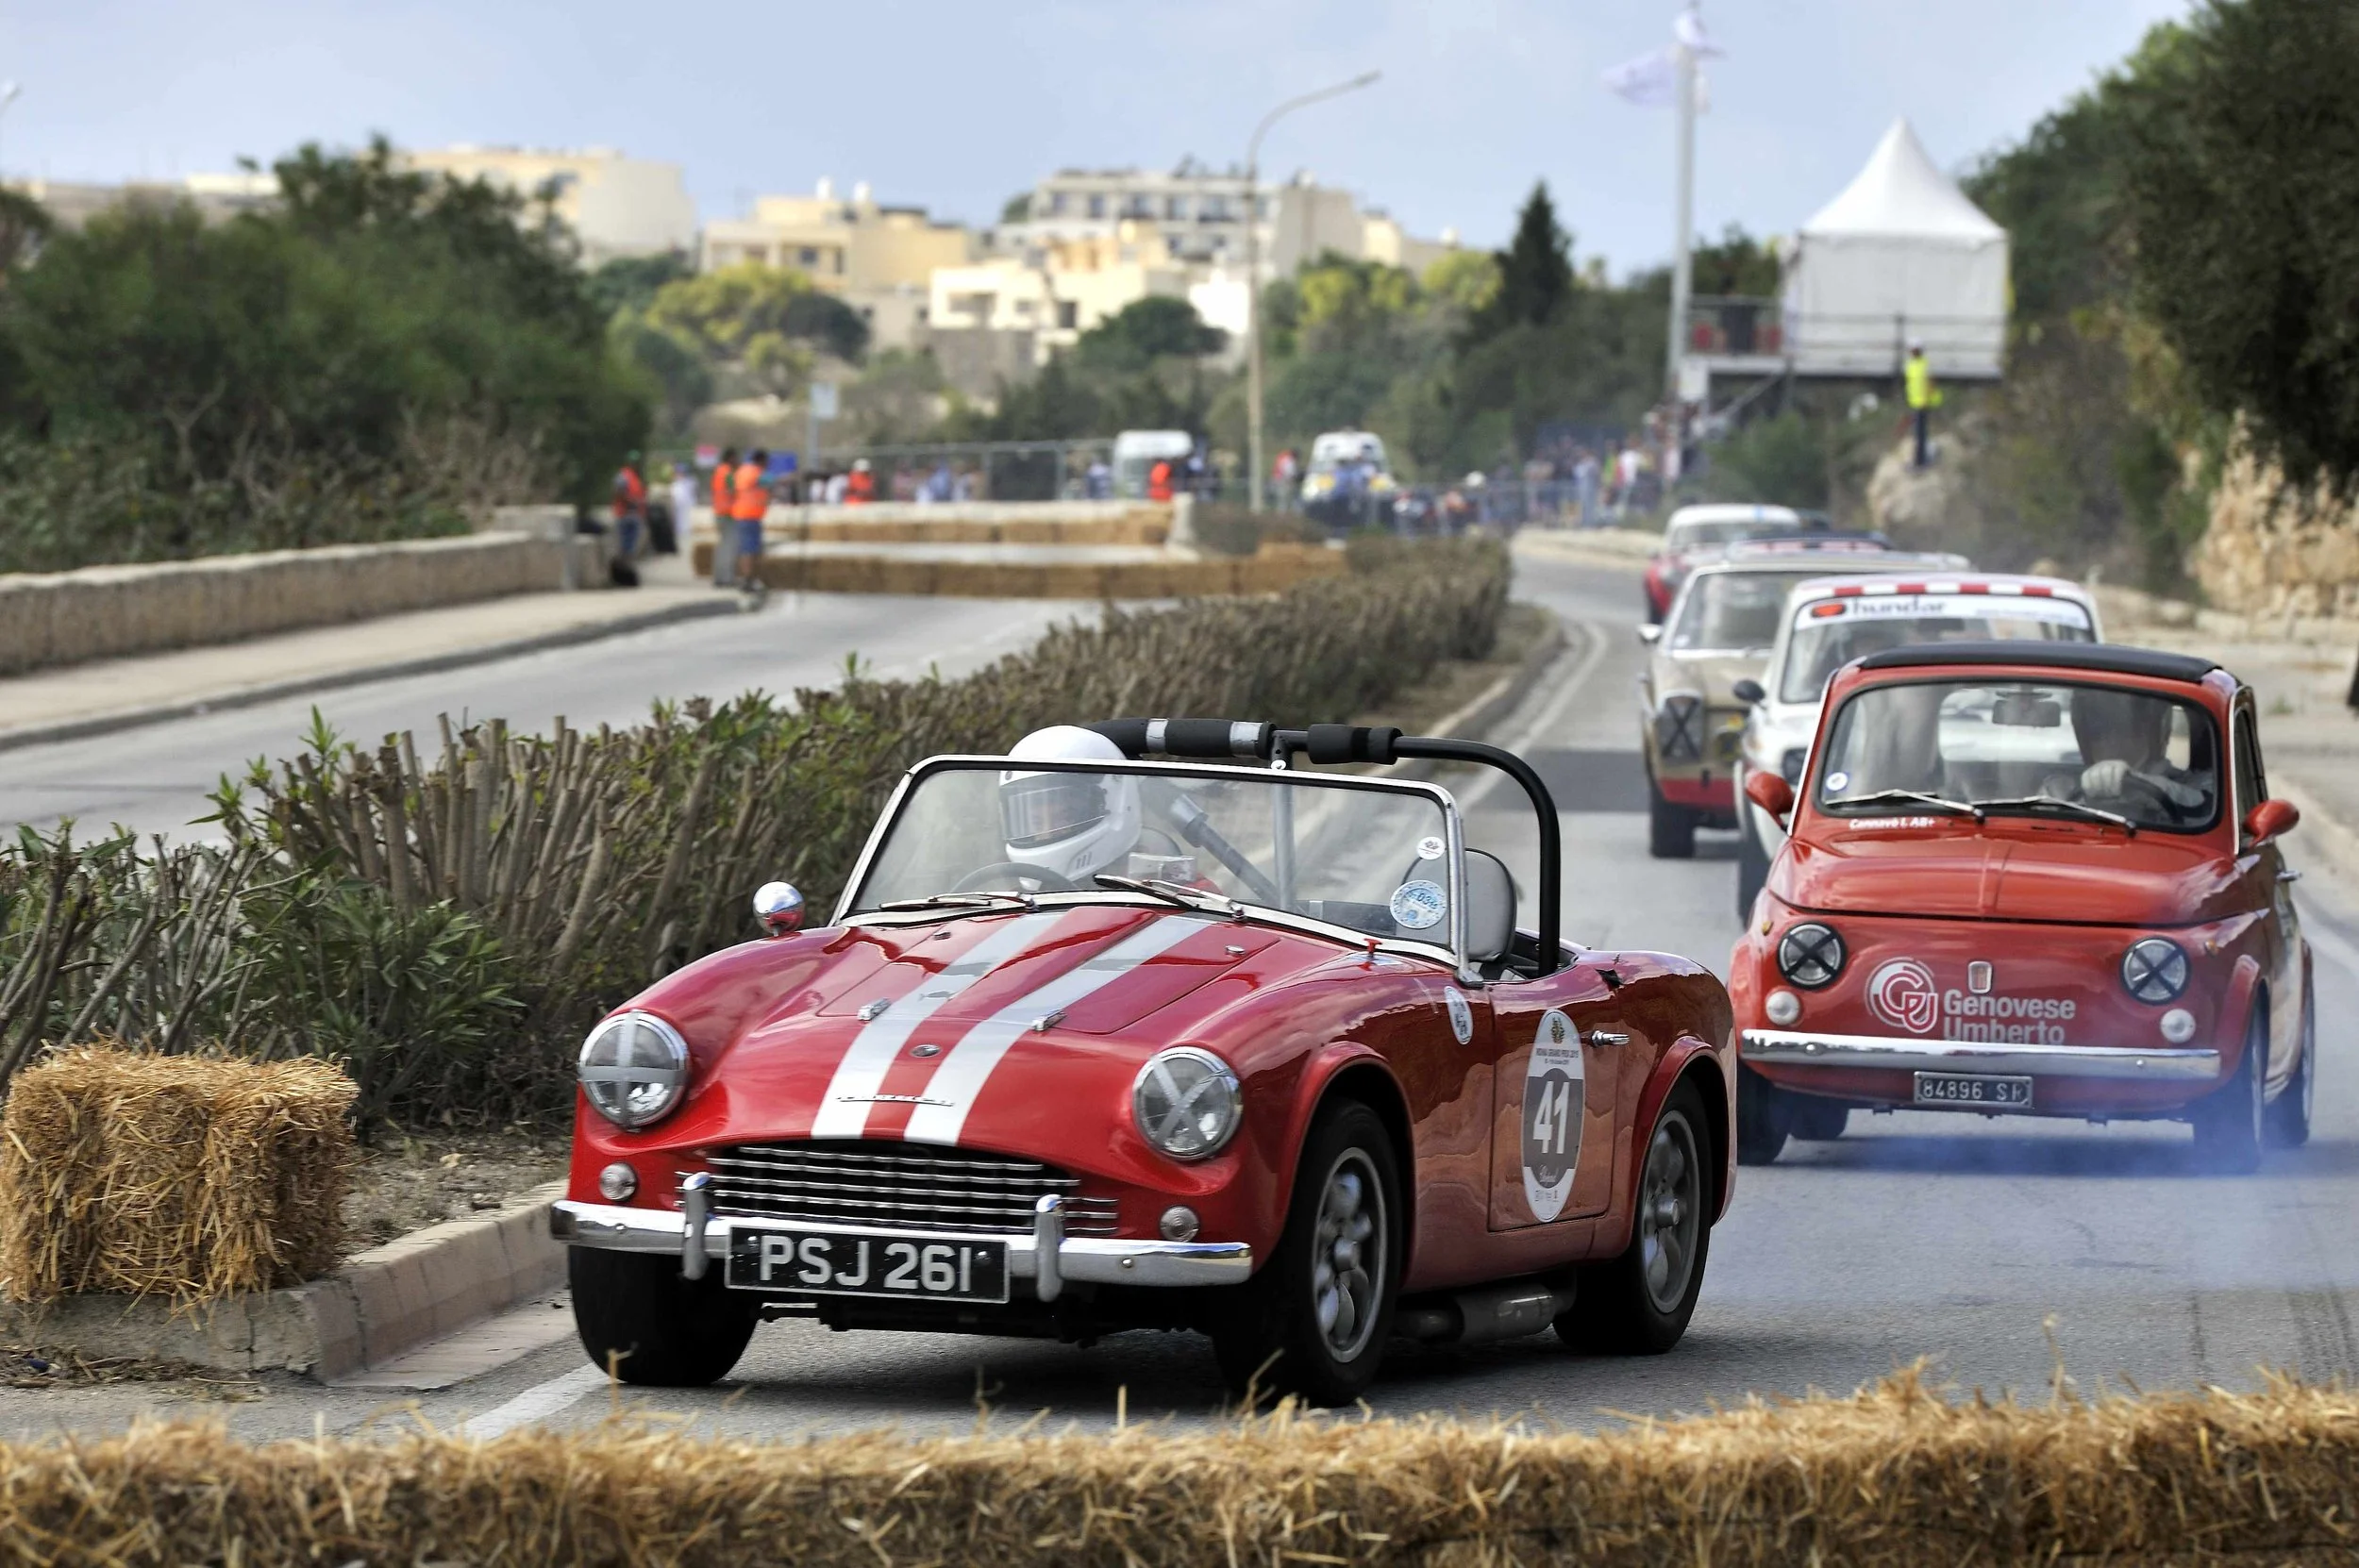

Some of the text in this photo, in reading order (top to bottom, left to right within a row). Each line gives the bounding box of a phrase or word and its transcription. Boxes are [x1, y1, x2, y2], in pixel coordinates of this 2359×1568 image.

[1943, 989, 2077, 1020] Genovese
[1943, 1016, 2066, 1045] Umberto
[1922, 1079, 1983, 1100] 84896
[1532, 1080, 1570, 1155] 41
[760, 1235, 972, 1293] PSJ 261
